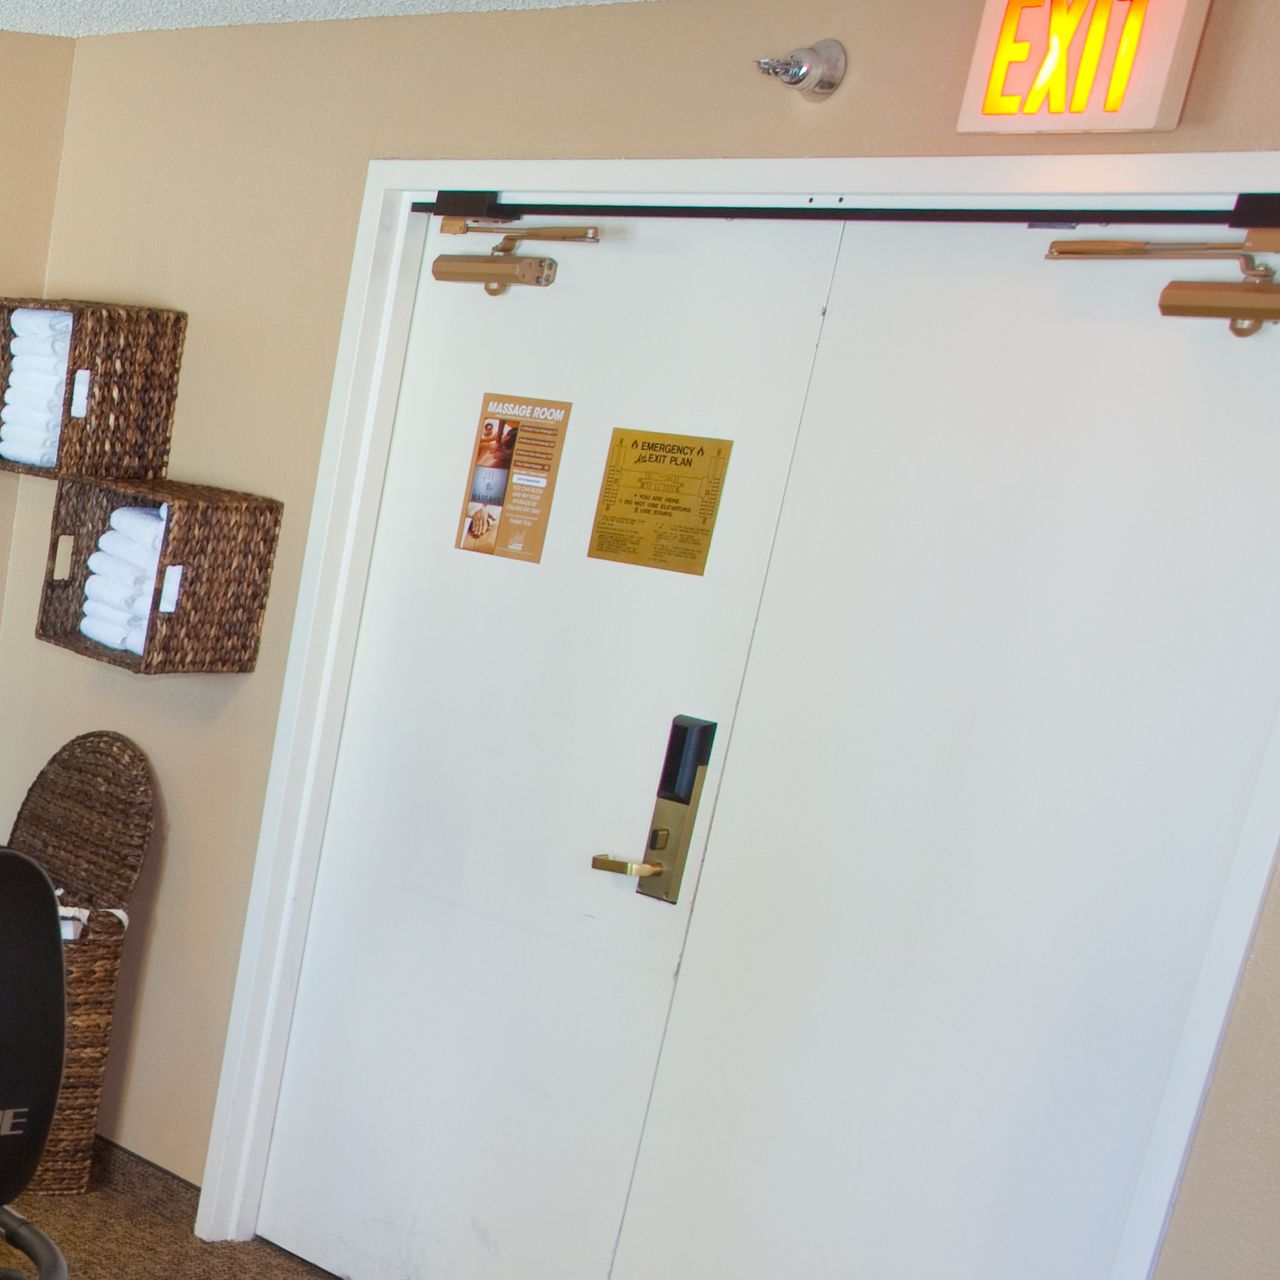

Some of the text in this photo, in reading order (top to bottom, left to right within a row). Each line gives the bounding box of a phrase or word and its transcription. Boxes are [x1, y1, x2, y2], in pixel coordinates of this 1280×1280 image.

[981, 0, 1150, 116] EXIT
[487, 401, 533, 417] MASSAGE
[532, 407, 565, 421] ROOM
[641, 442, 695, 456] EMERGENCY
[648, 453, 668, 463] EXIT
[670, 456, 693, 467] PLAN
[664, 496, 680, 504] HERE
[660, 503, 691, 513] ELEVATORS
